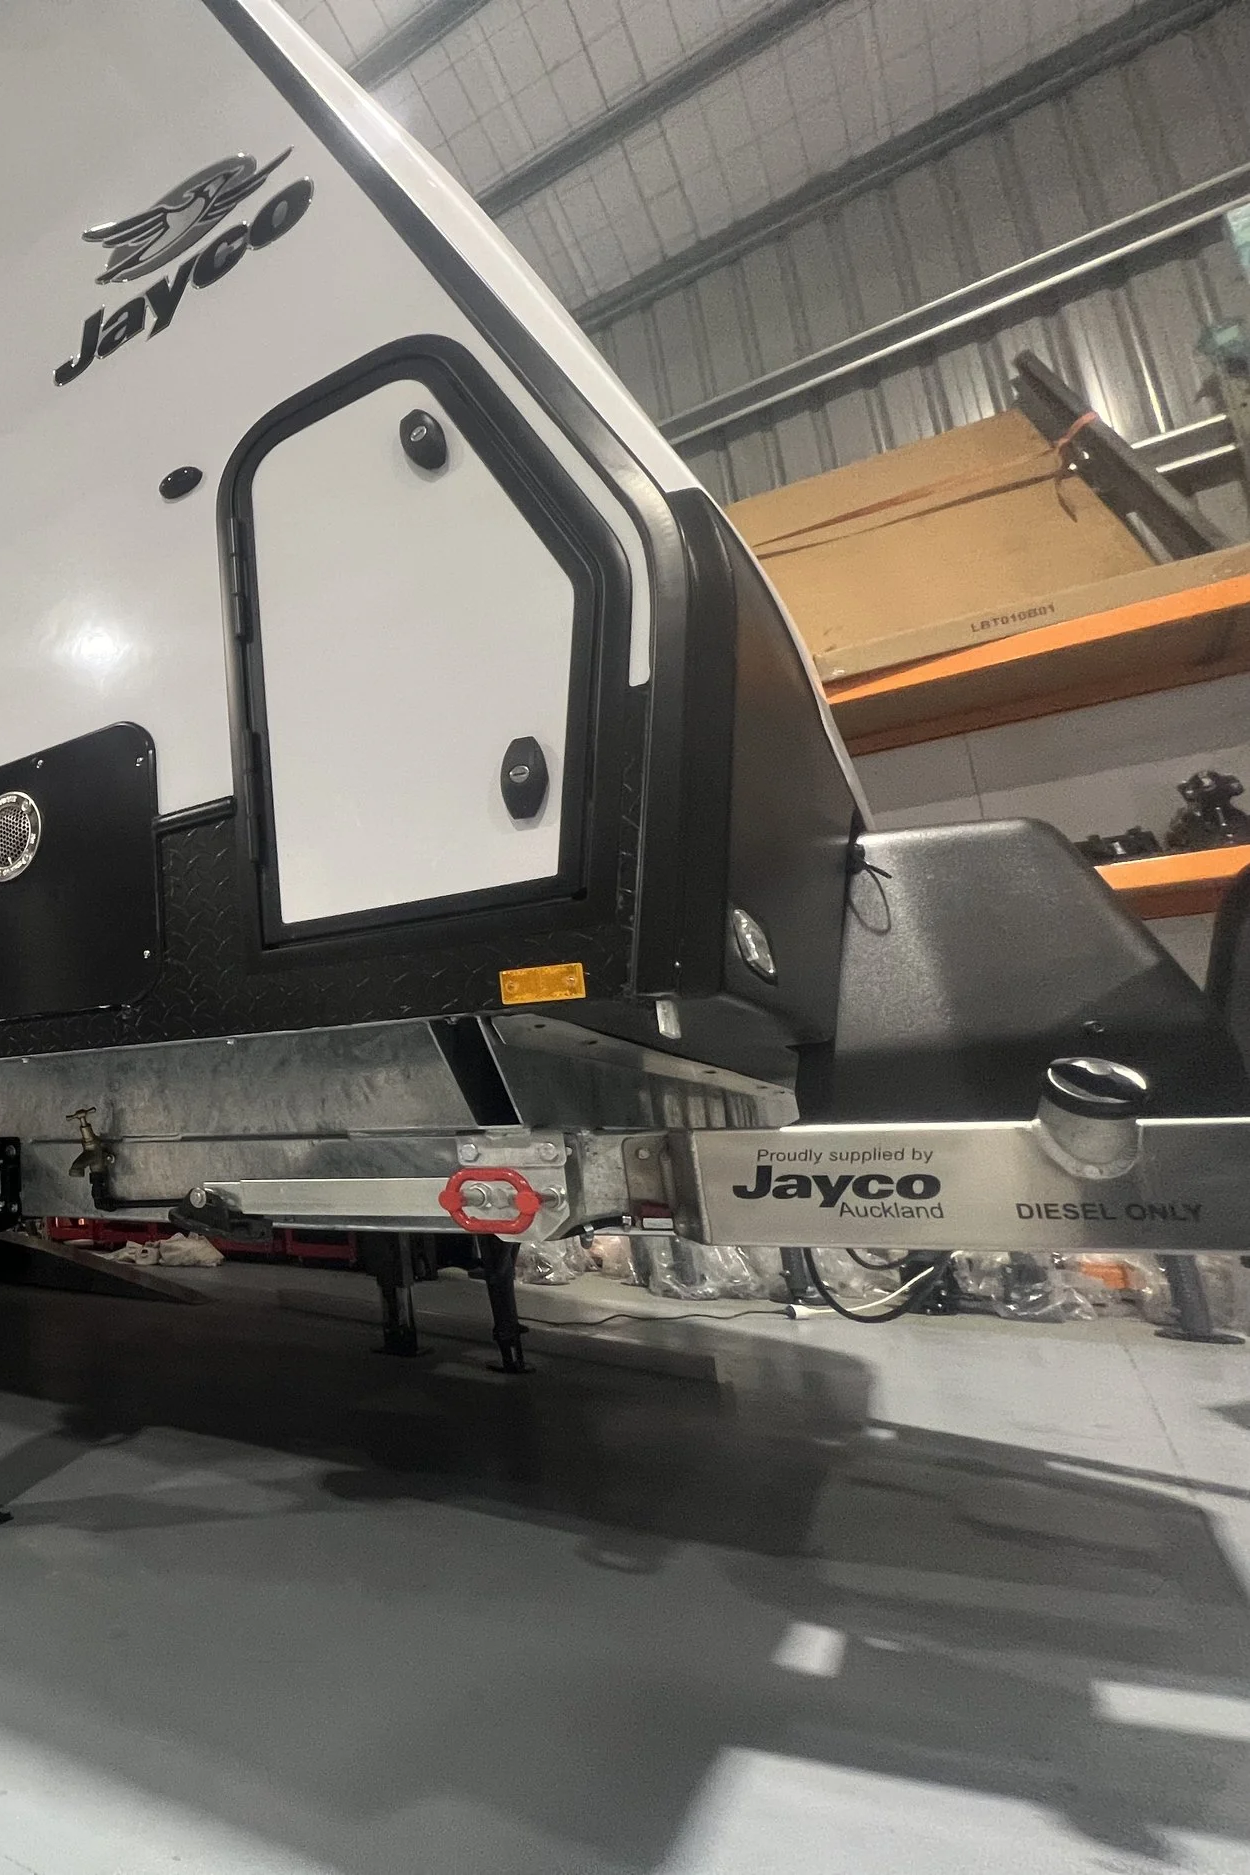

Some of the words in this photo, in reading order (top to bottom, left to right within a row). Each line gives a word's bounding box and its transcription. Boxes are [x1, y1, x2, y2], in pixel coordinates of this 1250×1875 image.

[53, 176, 315, 387] Jayco
[756, 1149, 823, 1165] Proudly
[829, 1148, 905, 1164] supplied
[911, 1148, 934, 1164] by
[732, 1165, 941, 1208] Jayco
[839, 1202, 945, 1219] Auckland
[1015, 1202, 1117, 1221] DIESEL
[1124, 1203, 1203, 1222] ONLY
